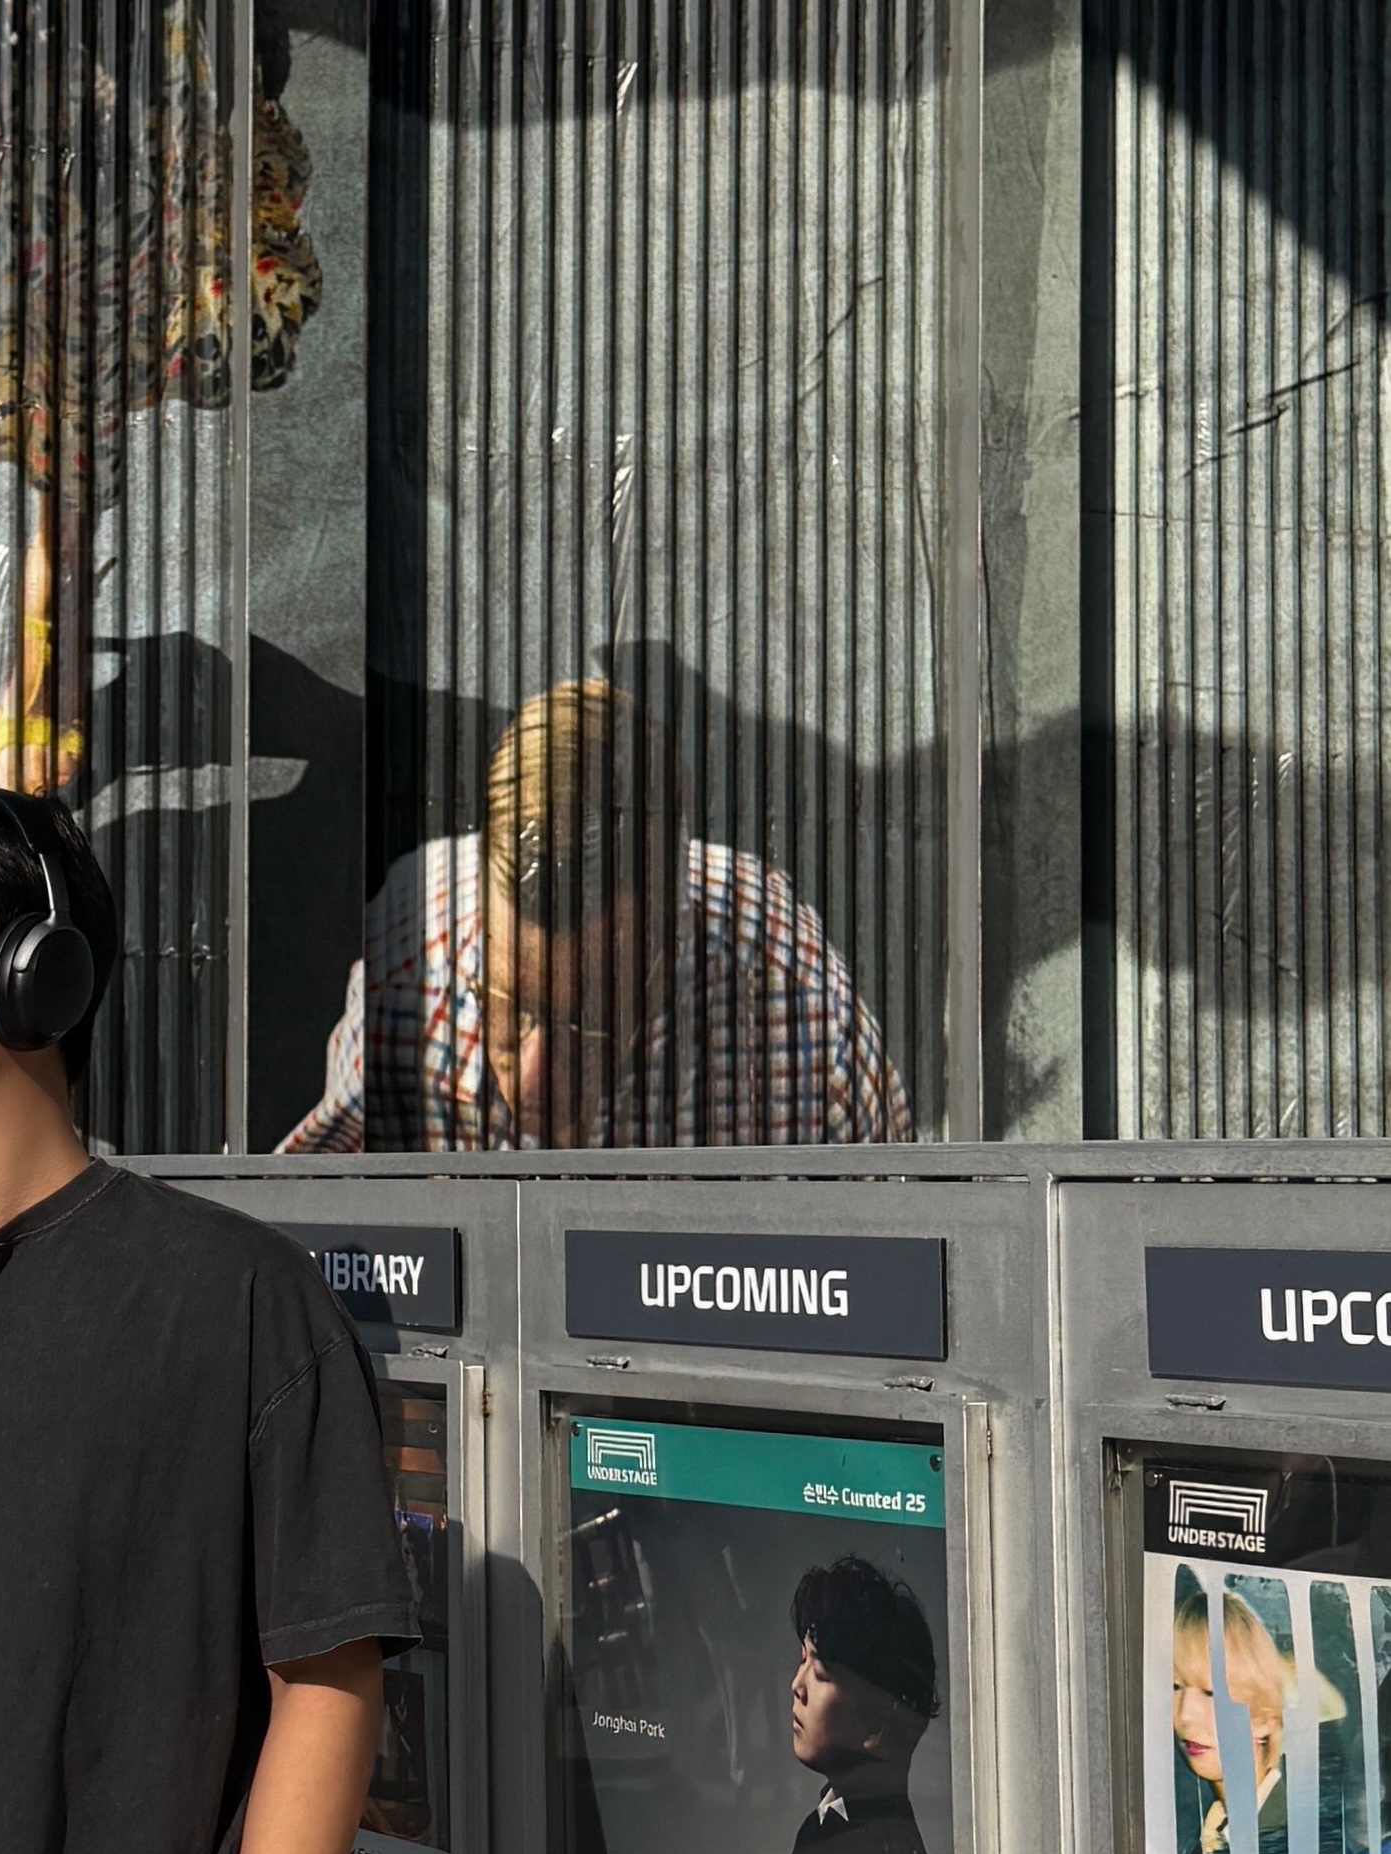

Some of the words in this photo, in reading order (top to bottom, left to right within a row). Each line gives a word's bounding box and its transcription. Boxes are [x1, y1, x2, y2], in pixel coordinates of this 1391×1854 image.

[310, 1251, 425, 1296] IBRARY
[640, 1262, 849, 1317] UPCOMING
[587, 1464, 657, 1486] UNDERSTAGE
[841, 1487, 902, 1511] Curated
[905, 1493, 926, 1513] 25
[1167, 1525, 1266, 1553] UNDERSTAGE
[639, 1719, 666, 1739] Park
